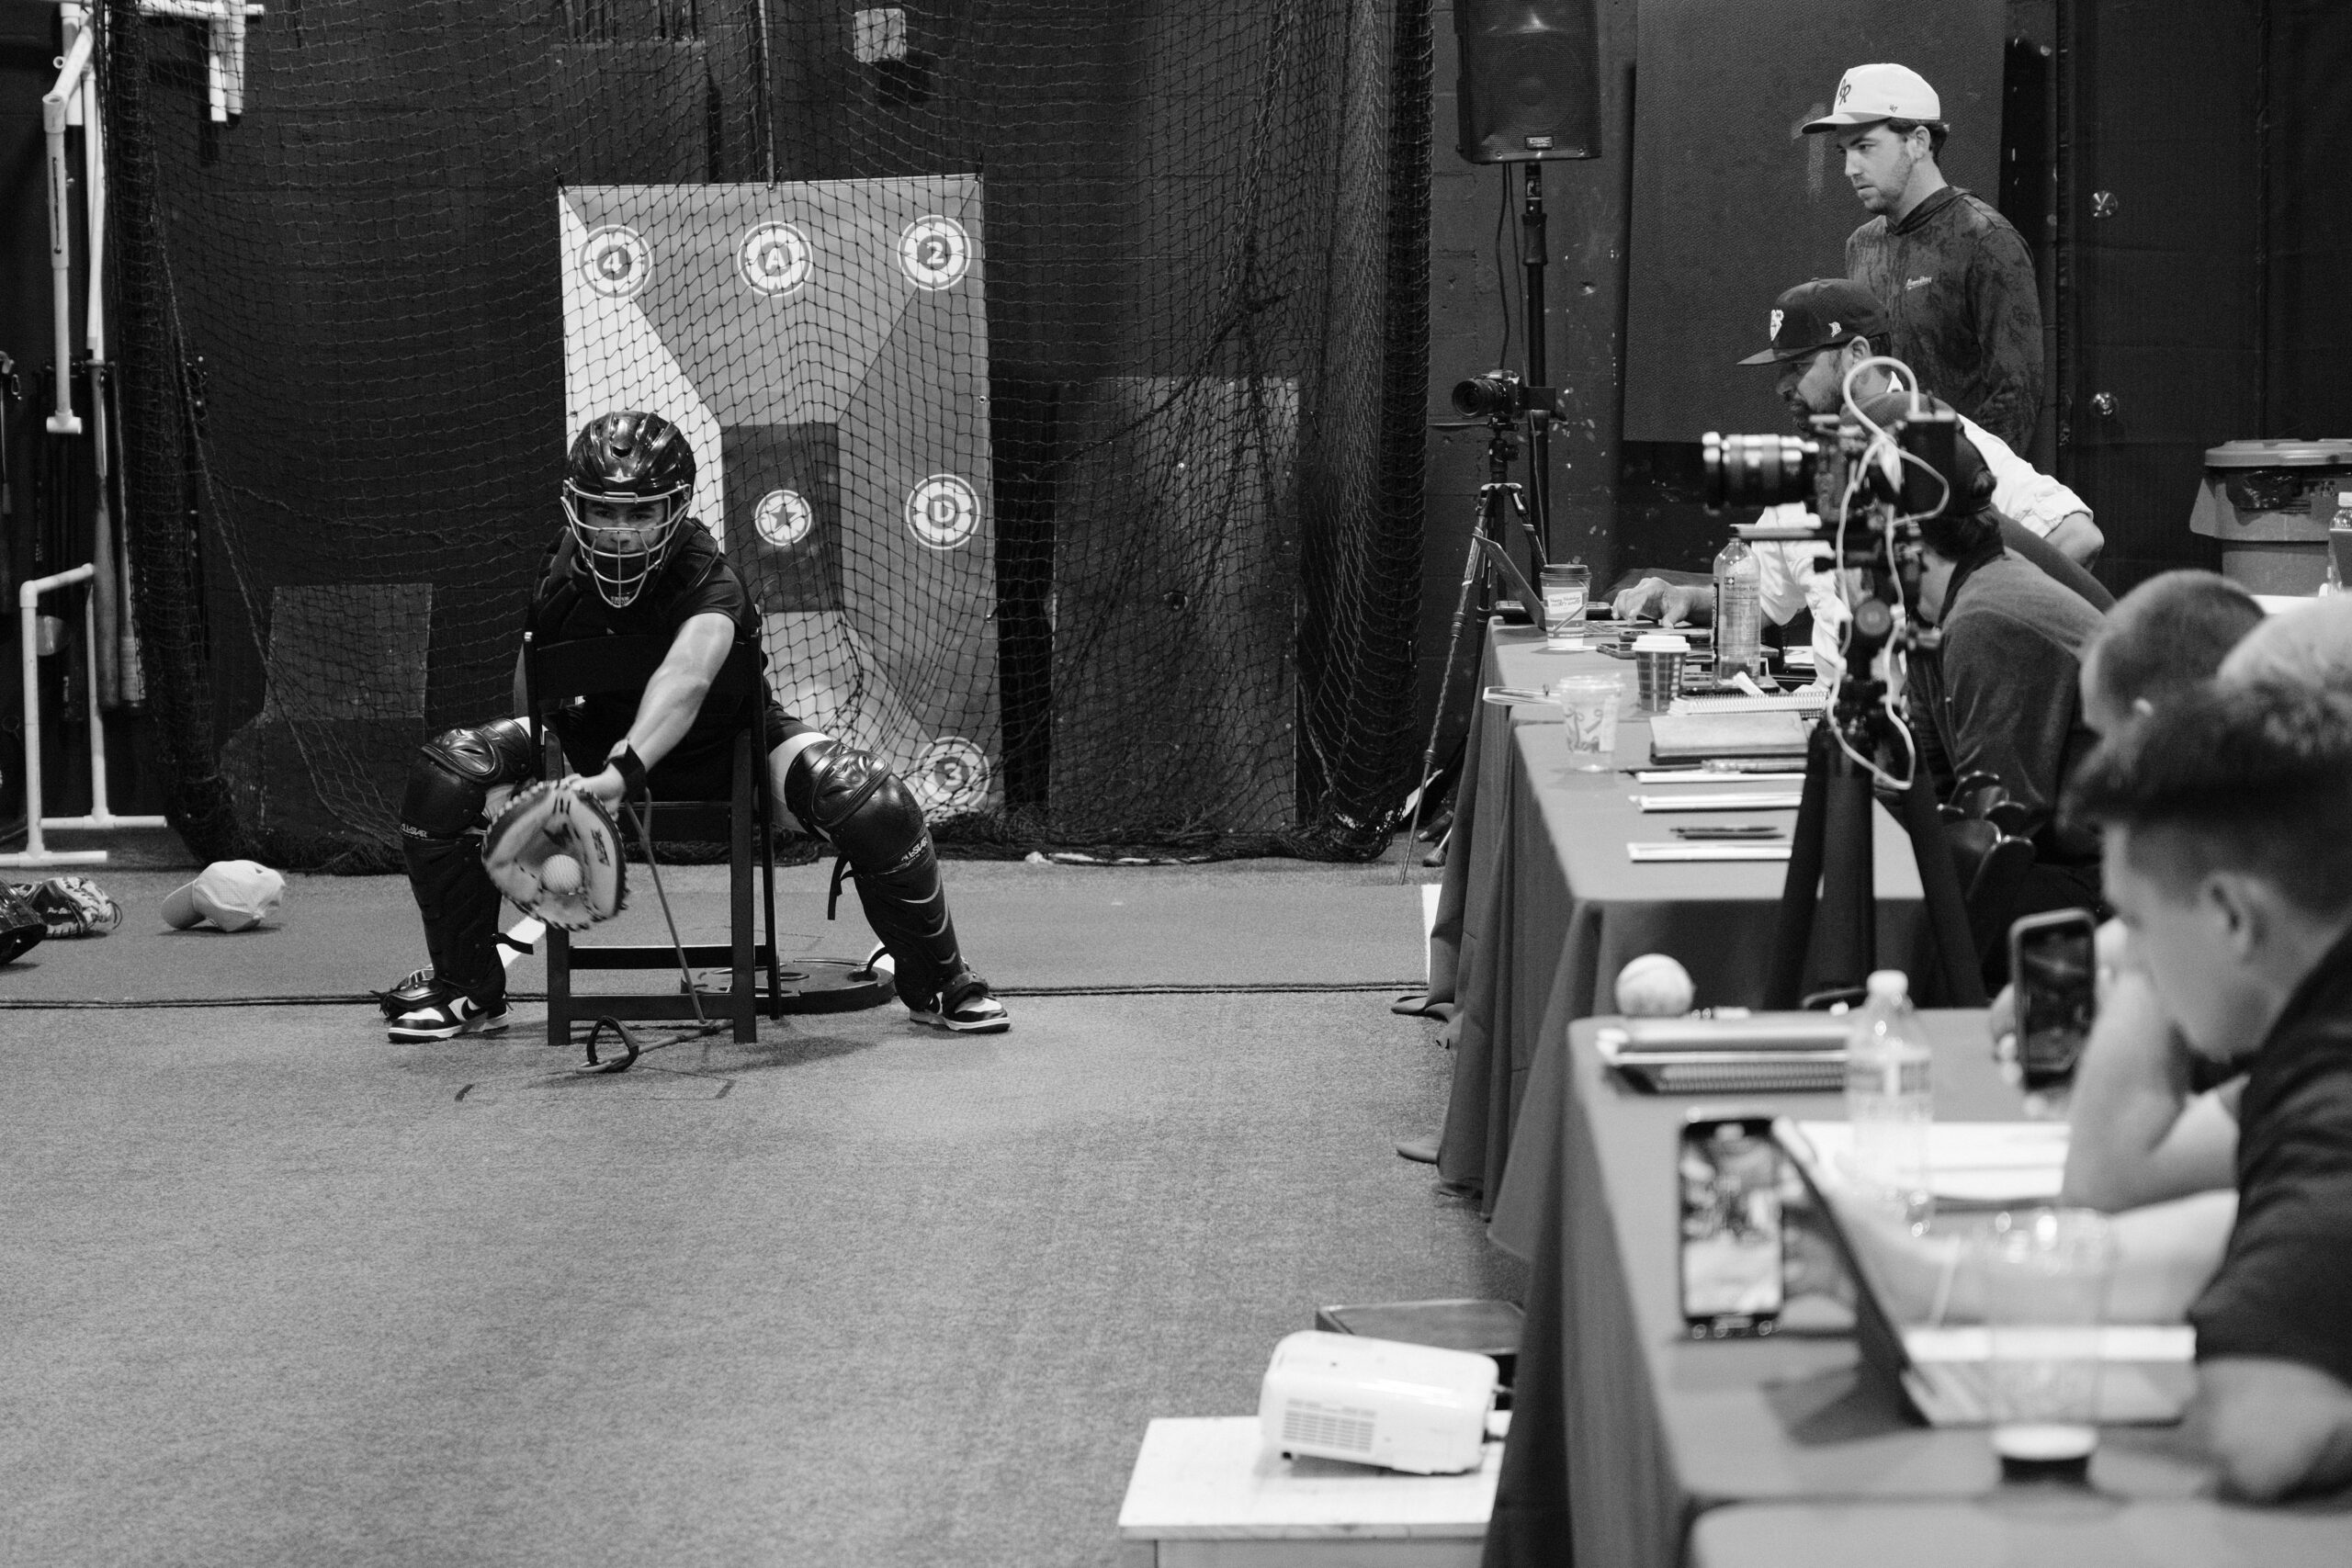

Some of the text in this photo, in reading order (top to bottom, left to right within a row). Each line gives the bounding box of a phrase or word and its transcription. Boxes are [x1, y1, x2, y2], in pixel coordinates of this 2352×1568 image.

[603, 251, 623, 274] 4
[764, 247, 787, 270] A
[926, 241, 944, 265] 2
[933, 500, 956, 523] D
[944, 762, 962, 786] 3
